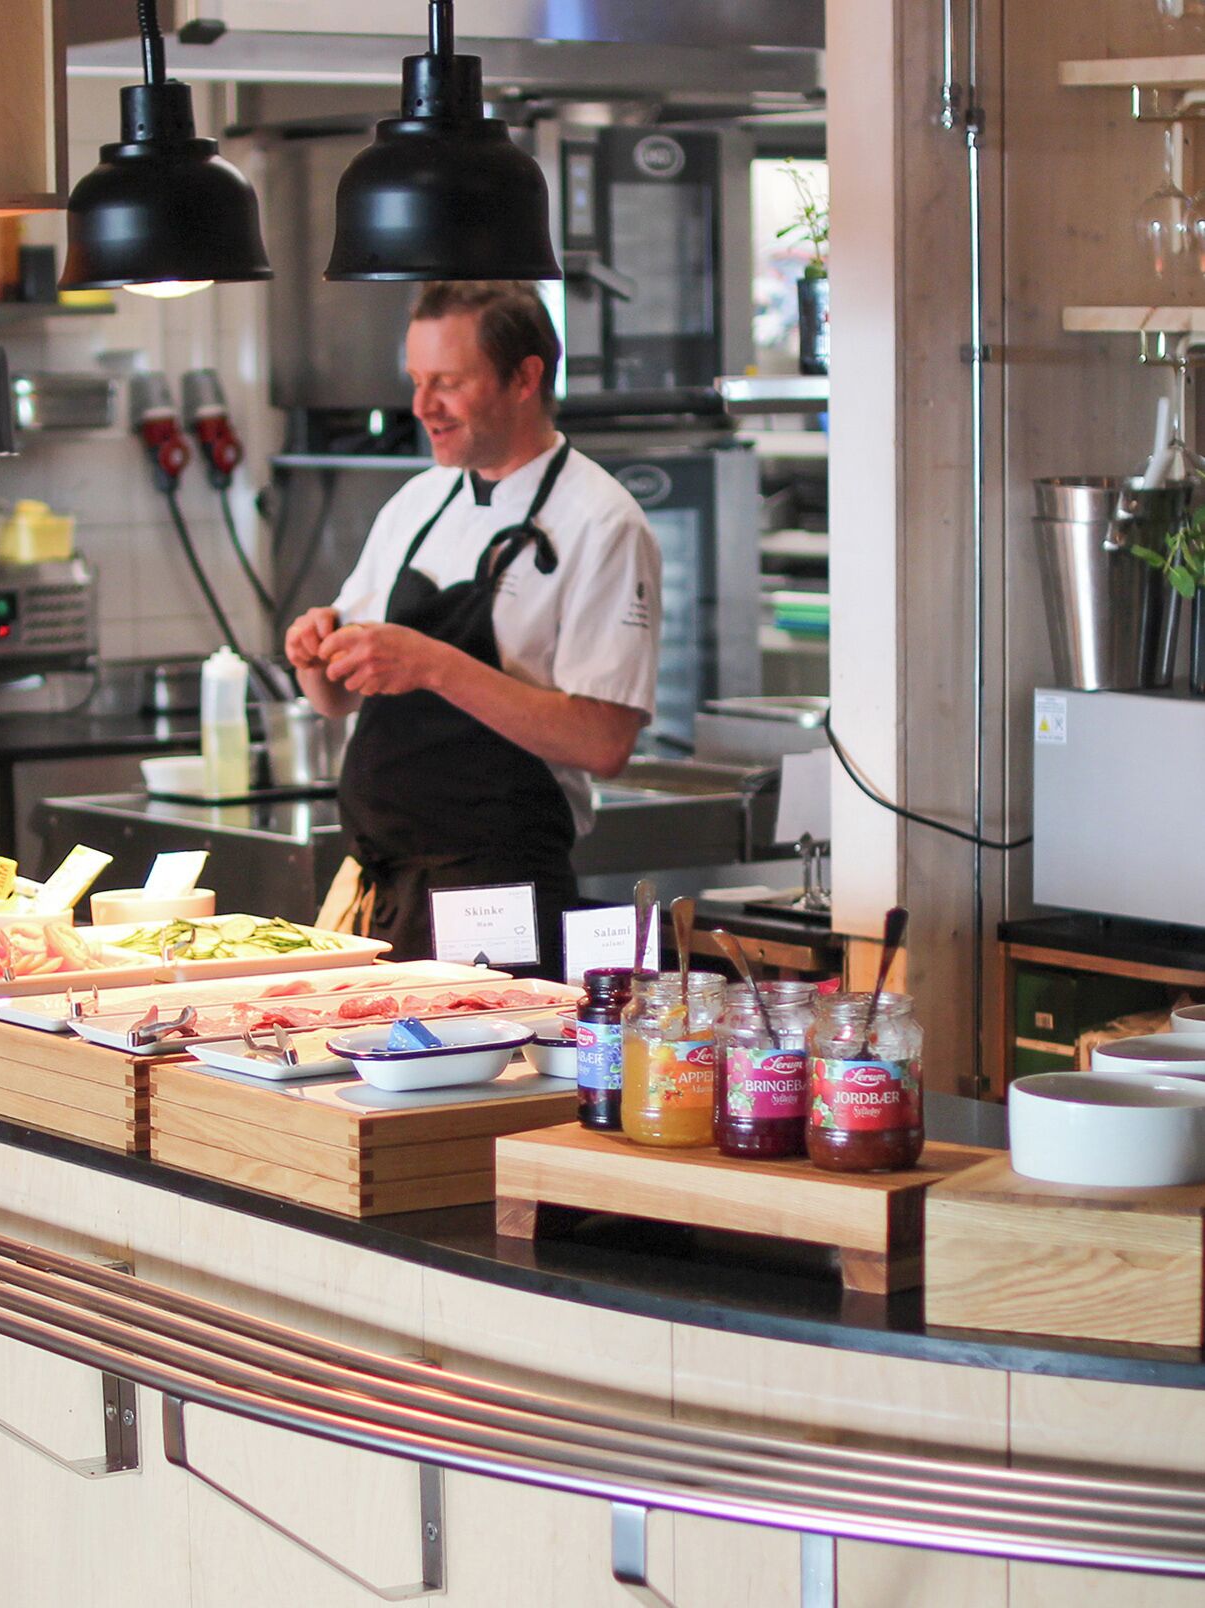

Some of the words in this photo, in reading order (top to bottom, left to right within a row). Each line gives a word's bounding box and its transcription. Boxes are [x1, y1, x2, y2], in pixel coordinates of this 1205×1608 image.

[464, 906, 505, 917] Skinke
[593, 925, 632, 938] Salami
[762, 1055, 804, 1075] Lerum
[844, 1067, 887, 1087] Lerum
[833, 1090, 900, 1105] JORDBÆR
